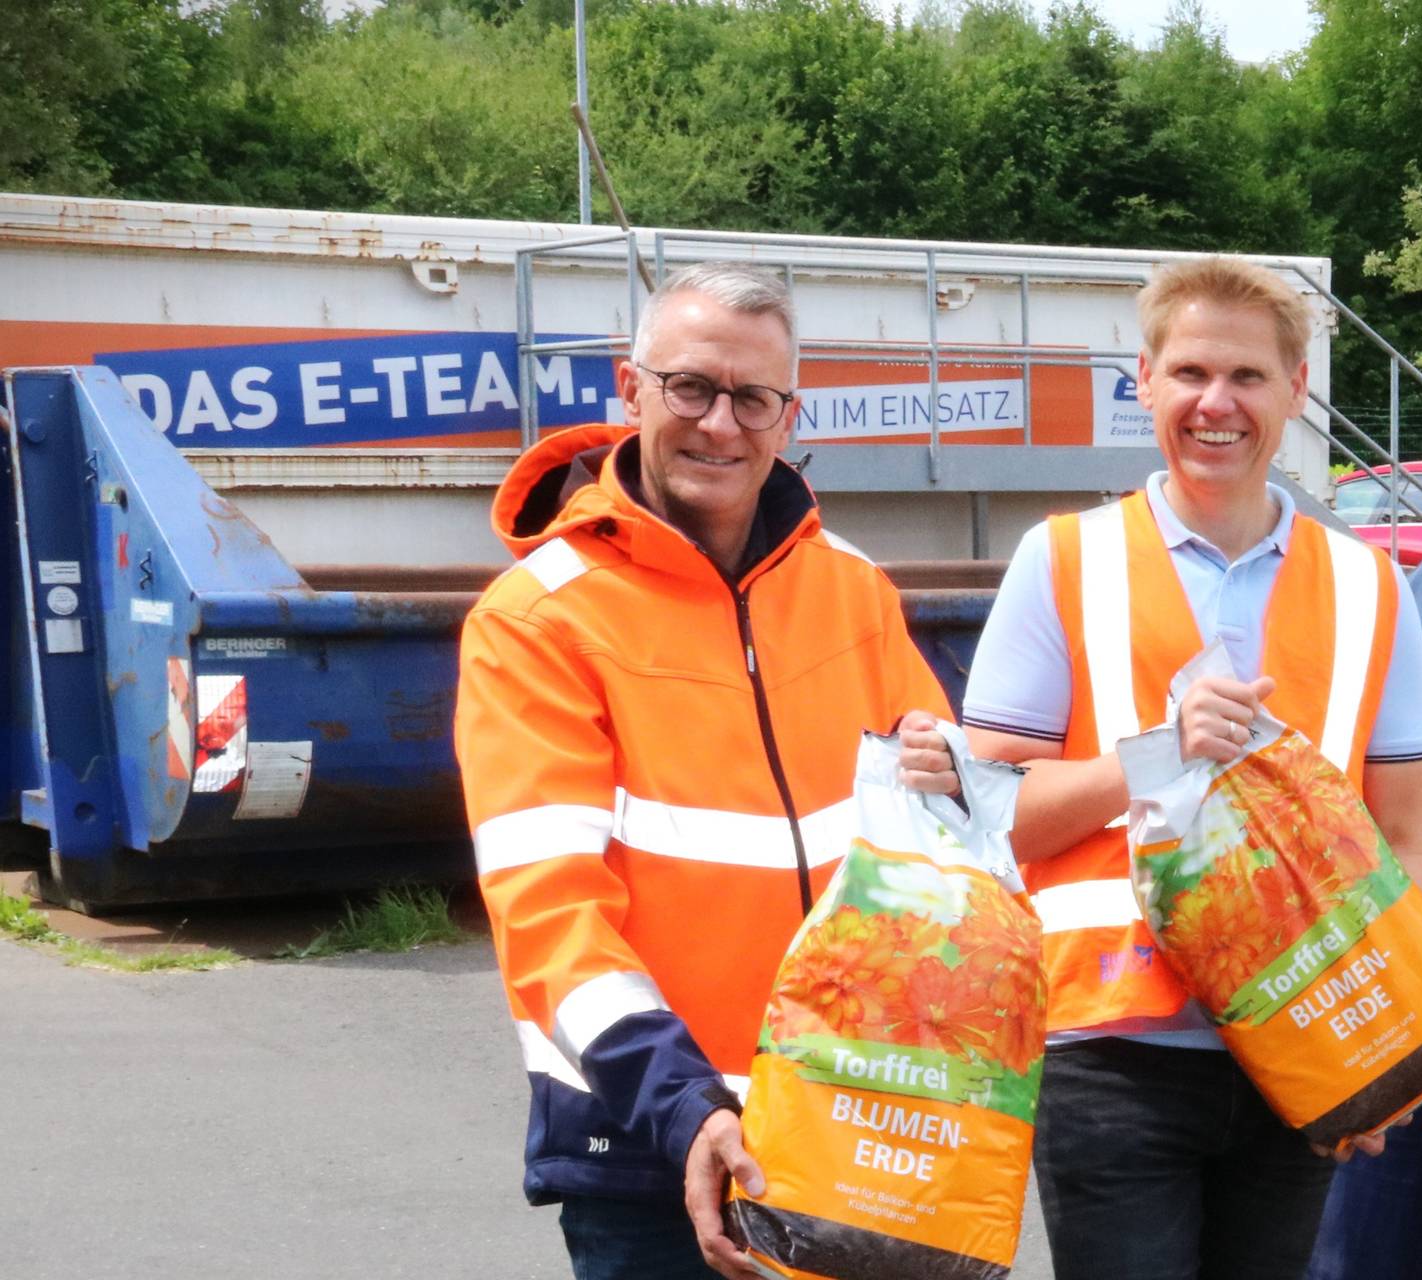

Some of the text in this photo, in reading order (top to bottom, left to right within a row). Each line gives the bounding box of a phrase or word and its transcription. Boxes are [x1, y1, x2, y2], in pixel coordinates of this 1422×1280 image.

[121, 352, 596, 435] DAS E-TEAM.
[832, 398, 867, 428] IM
[881, 390, 1018, 426] EINSATZ.
[206, 638, 287, 651] BERINGER
[1258, 921, 1347, 1002] Torffrei
[1288, 948, 1393, 1030] BLUMEN-
[1327, 984, 1393, 1042] ERDE
[832, 1048, 949, 1091] Torffrei
[831, 1093, 970, 1150] BLUMEN-
[854, 1139, 935, 1182] ERDE
[916, 1203, 937, 1216] und
